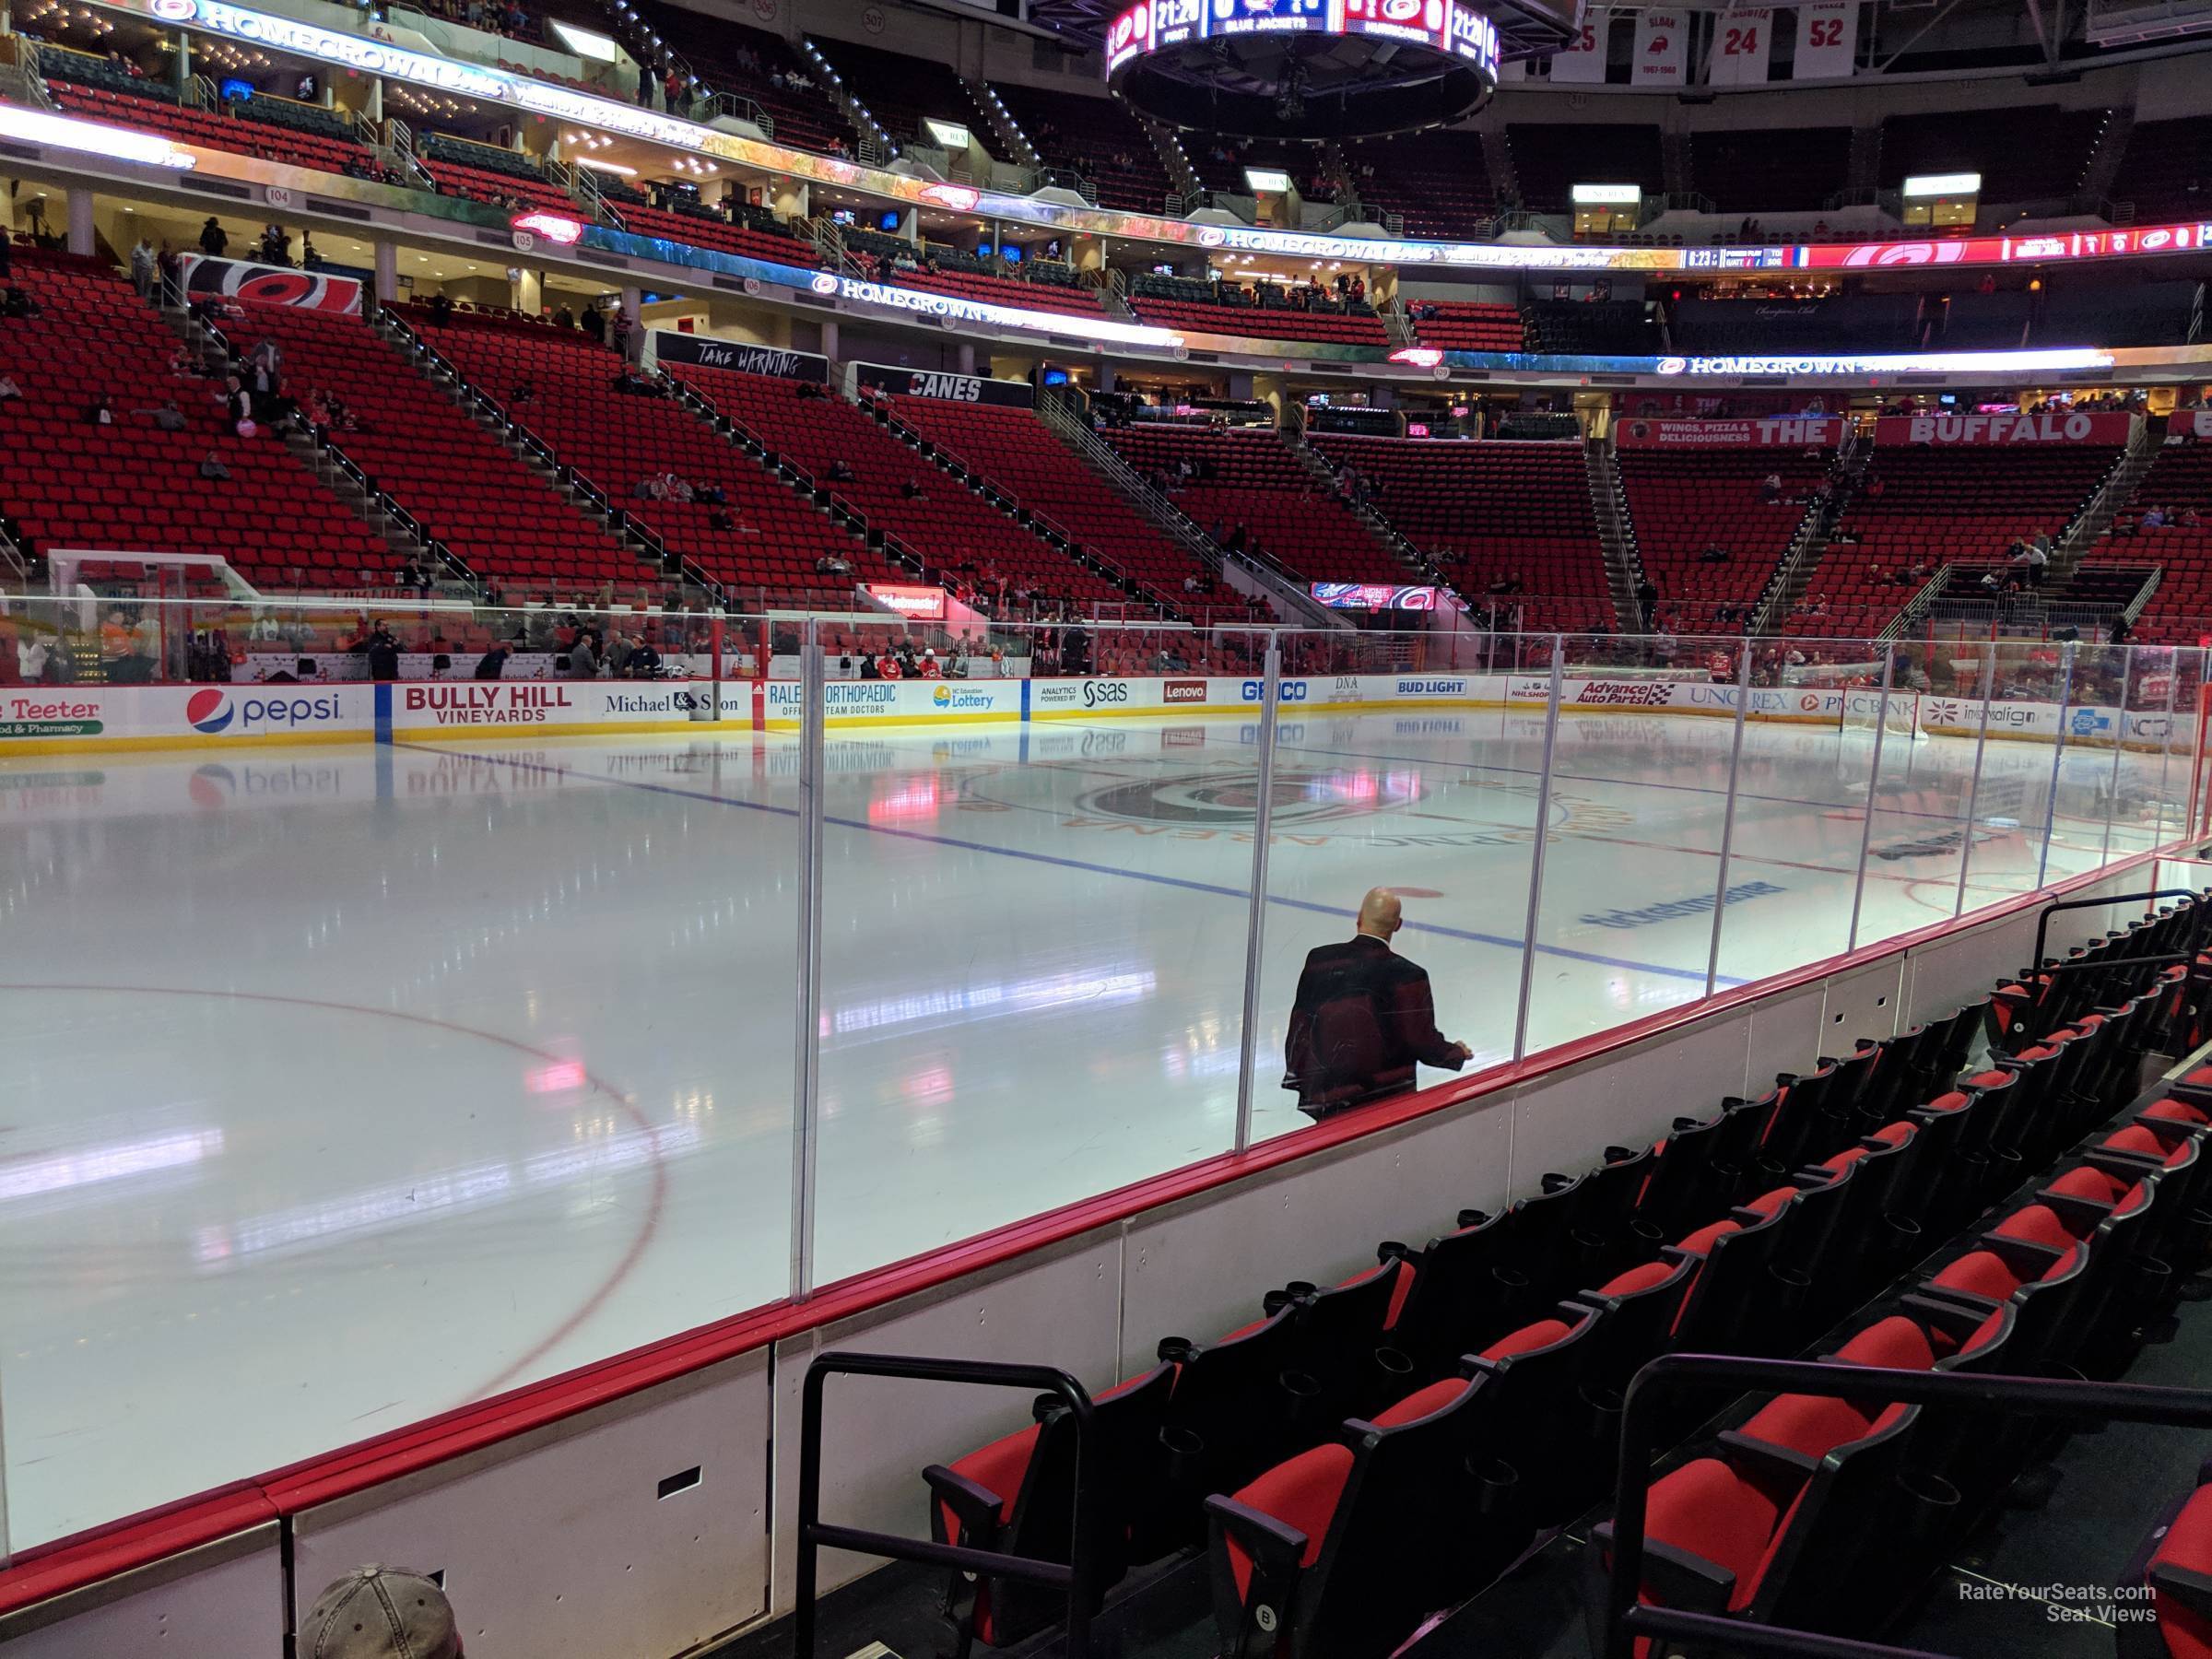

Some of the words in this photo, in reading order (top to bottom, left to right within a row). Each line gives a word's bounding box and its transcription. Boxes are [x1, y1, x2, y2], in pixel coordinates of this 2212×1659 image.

[865, 14, 882, 28] 307
[1225, 18, 1253, 33] BLUE
[1256, 17, 1308, 29] JACKETS
[1649, 17, 1677, 29] SLOAN
[1568, 25, 1595, 52] 5
[1809, 18, 1844, 47] 52
[205, 6, 441, 81] HOMEGROWN
[1724, 27, 1758, 55] 24
[270, 189, 288, 202] 104
[515, 235, 531, 247] 105
[1230, 231, 1386, 261] HOMEGROWN
[1688, 250, 1711, 266] 6:23
[746, 280, 759, 291] 106
[842, 278, 982, 322] HOMEGROWN
[943, 317, 954, 326] 107
[1175, 347, 1187, 358] 108
[1435, 369, 1448, 377] 109
[1692, 357, 1856, 374] HOMEGROWN
[909, 371, 982, 403] CANES
[1660, 423, 1703, 433] WINGS,
[1704, 423, 1738, 433] PIZZA
[1740, 423, 1750, 432] &
[1756, 420, 1829, 443] THE
[1910, 414, 2092, 442] BUFFALO
[1659, 432, 1750, 443] DELICIOUSNESS
[1335, 677, 1359, 689] DNA
[1398, 681, 1426, 693] BUD
[1428, 680, 1465, 693] LIGHT
[1583, 681, 1649, 695] Advance
[406, 687, 500, 711] BULLY
[511, 686, 572, 709] HILL
[825, 684, 896, 704] ORTHOPAEDIC
[1041, 687, 1077, 696] ANALYTICS
[1166, 685, 1204, 699] Lenovo
[1576, 692, 1606, 704] Auto
[1606, 693, 1644, 705] Parts
[1689, 687, 1740, 707] UNC
[1751, 692, 1789, 710] REX
[605, 695, 670, 712] Michael
[952, 694, 994, 709] Lottery
[1868, 698, 1915, 715] BNK
[11, 699, 100, 720] Teeter
[243, 693, 340, 727] pepsi
[437, 709, 547, 724] VINEYARDS
[826, 706, 848, 716] TEAM
[850, 705, 885, 715] DOCTORS
[14, 724, 26, 735] &
[28, 723, 84, 736] Pharmacy
[1261, 1609, 1271, 1625] B
